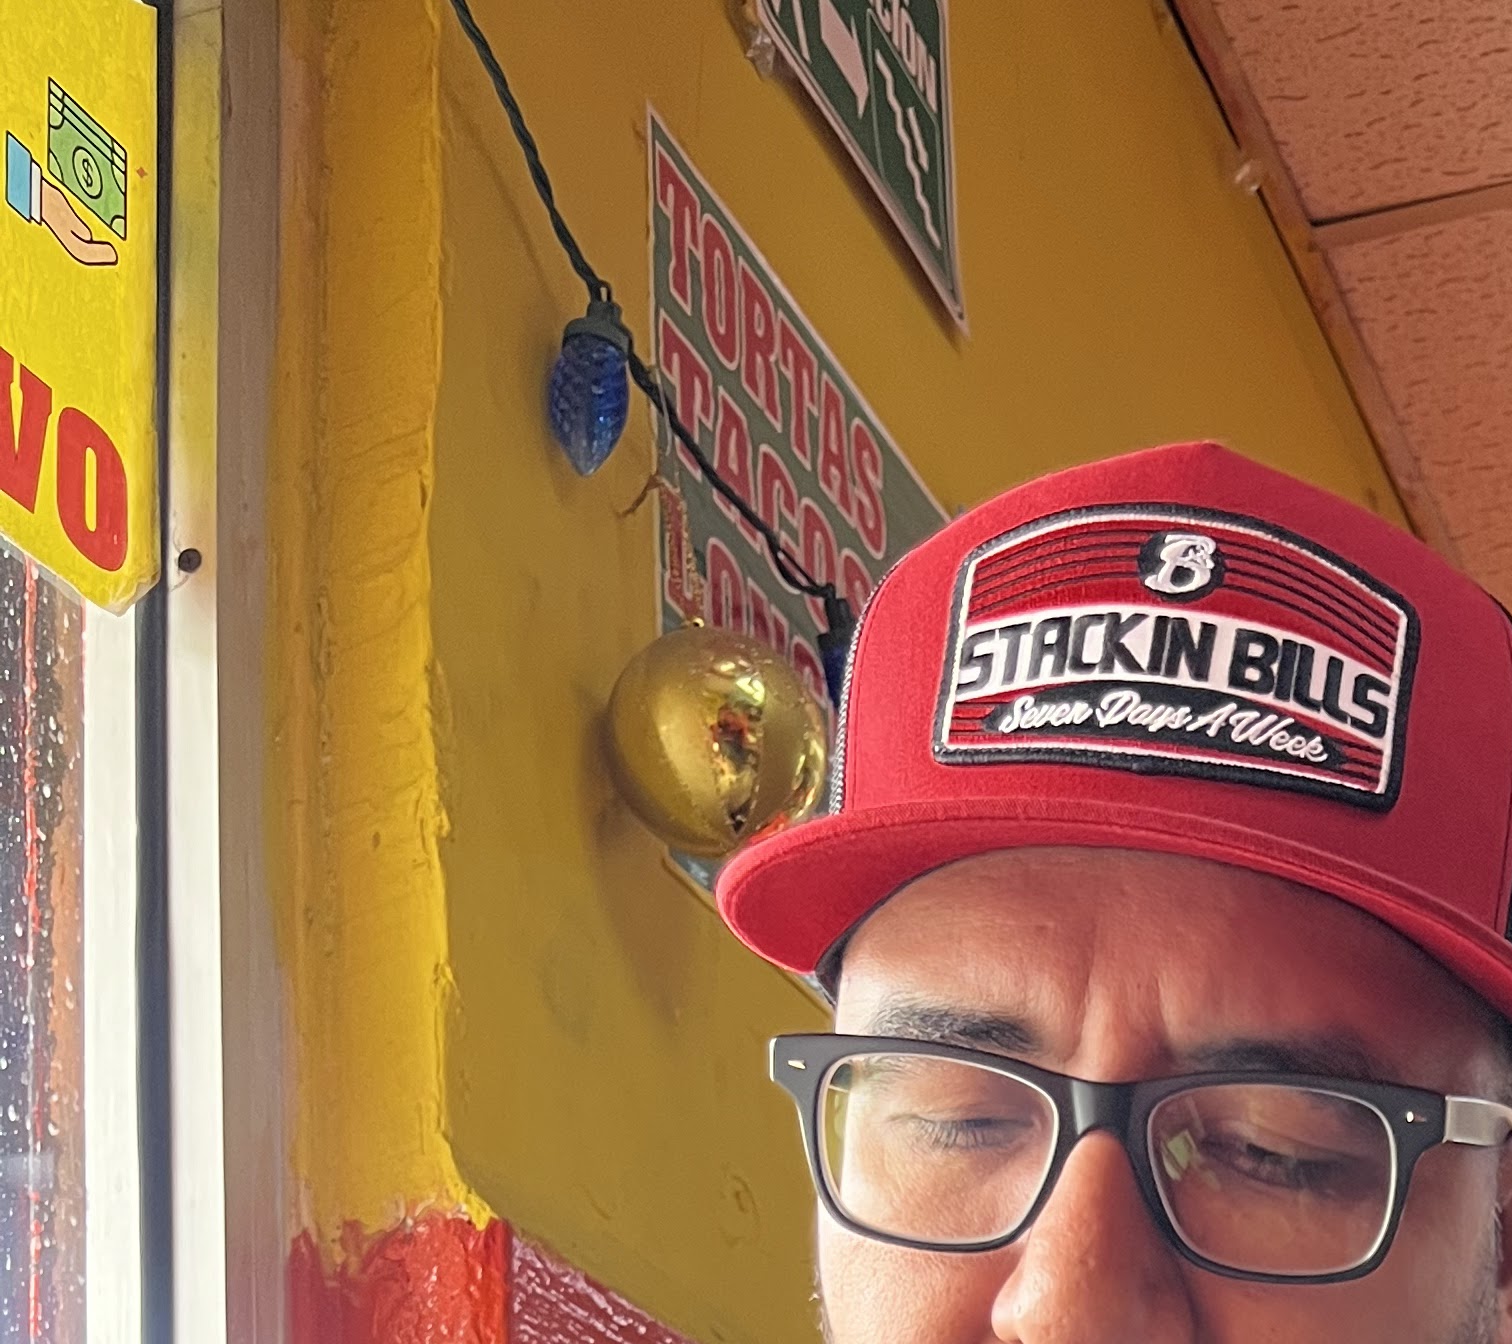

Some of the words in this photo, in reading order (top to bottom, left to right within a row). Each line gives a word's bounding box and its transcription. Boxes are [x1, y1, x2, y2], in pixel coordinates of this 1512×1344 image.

[655, 140, 887, 560] TORTAS
[957, 612, 1217, 696] STACKIN
[1227, 628, 1392, 738] BILLS
[998, 694, 1093, 734] Seven
[1096, 689, 1193, 733] Days
[1187, 702, 1237, 738] A
[1229, 711, 1328, 763] Week
